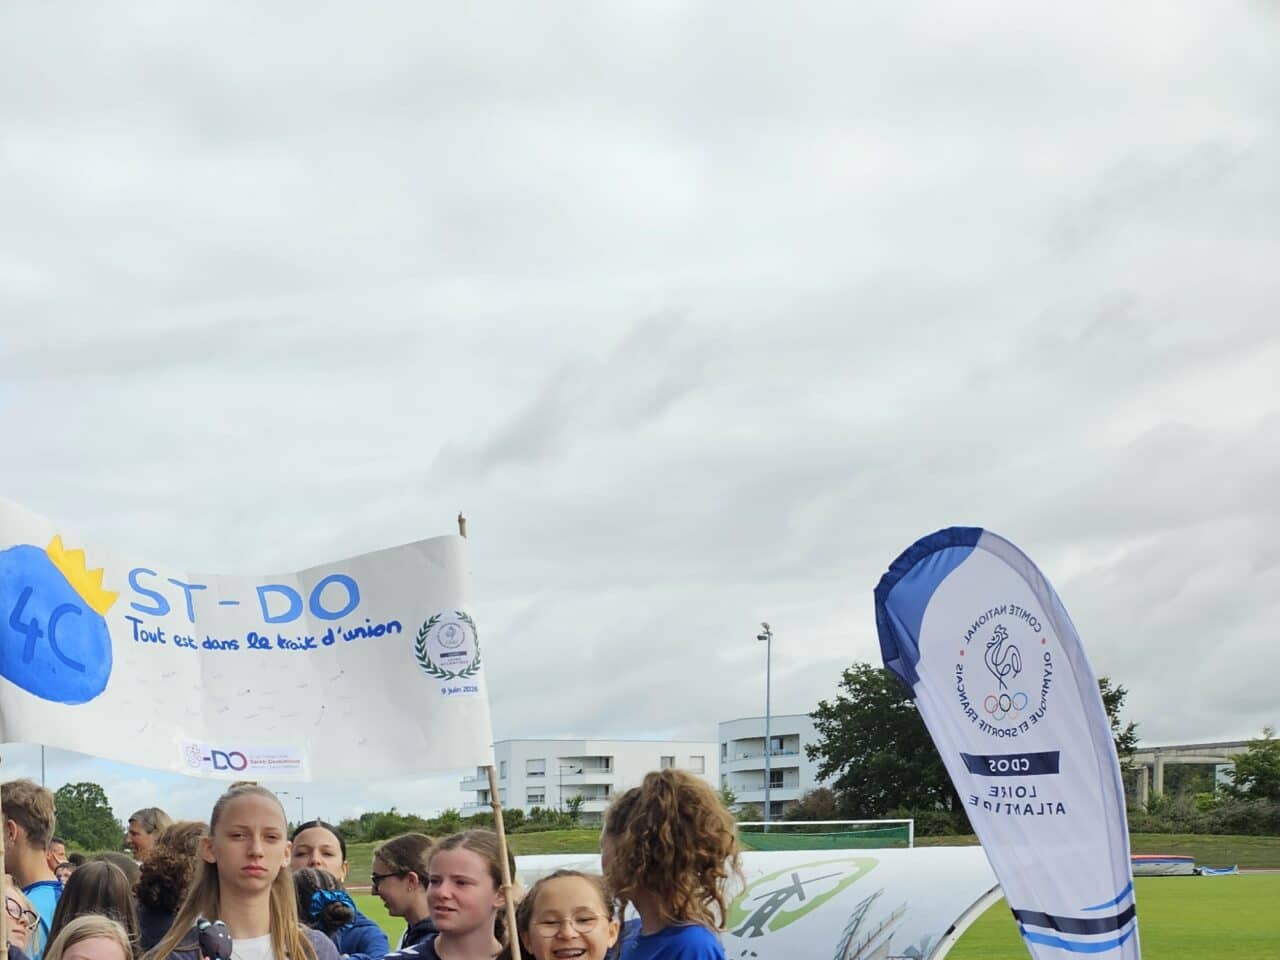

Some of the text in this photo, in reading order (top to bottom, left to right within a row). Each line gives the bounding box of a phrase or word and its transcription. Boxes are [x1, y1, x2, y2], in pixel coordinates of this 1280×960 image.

[8, 585, 87, 673] 4C
[124, 615, 166, 644] Tout
[173, 634, 198, 650] est
[201, 634, 240, 650] dans
[247, 631, 273, 650] le
[321, 618, 402, 646] d'union
